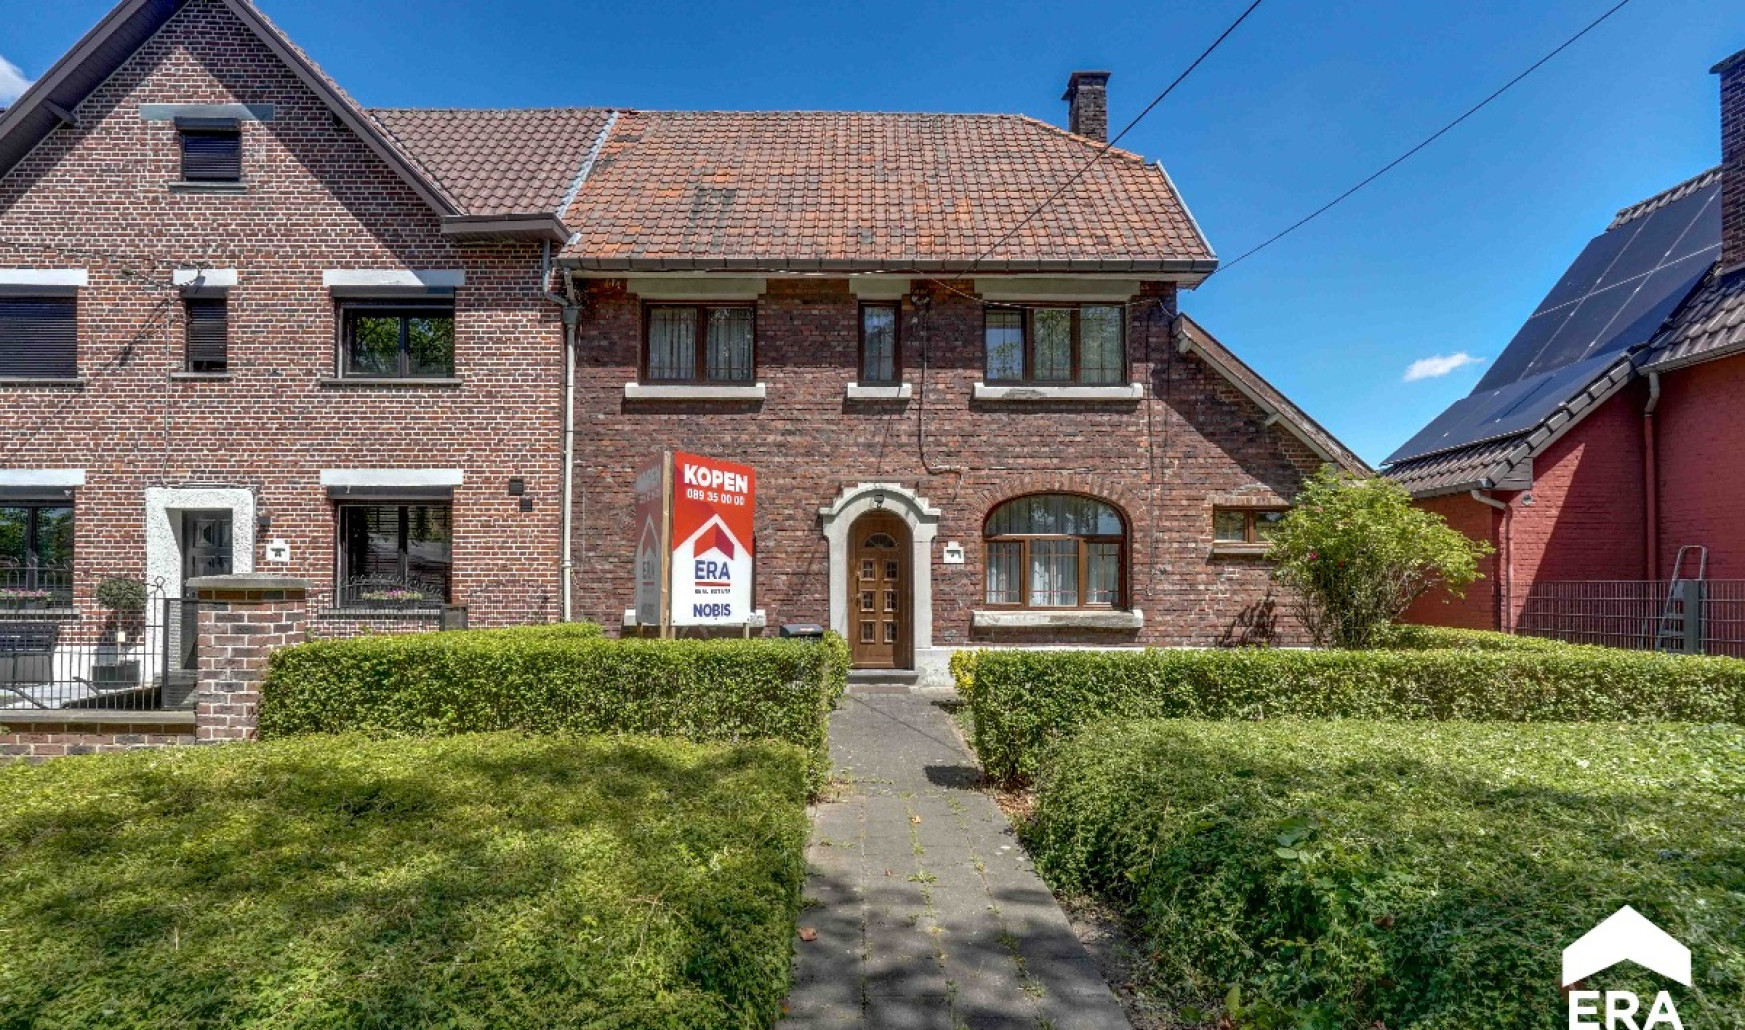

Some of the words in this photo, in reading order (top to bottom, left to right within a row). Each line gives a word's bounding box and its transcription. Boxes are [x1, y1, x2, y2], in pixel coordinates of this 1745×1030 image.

[684, 463, 748, 494] KOPEN
[687, 488, 704, 500] 089
[707, 491, 718, 502] 35
[721, 493, 732, 504] 00
[695, 560, 730, 580] ERA
[693, 603, 731, 617] NOBIS
